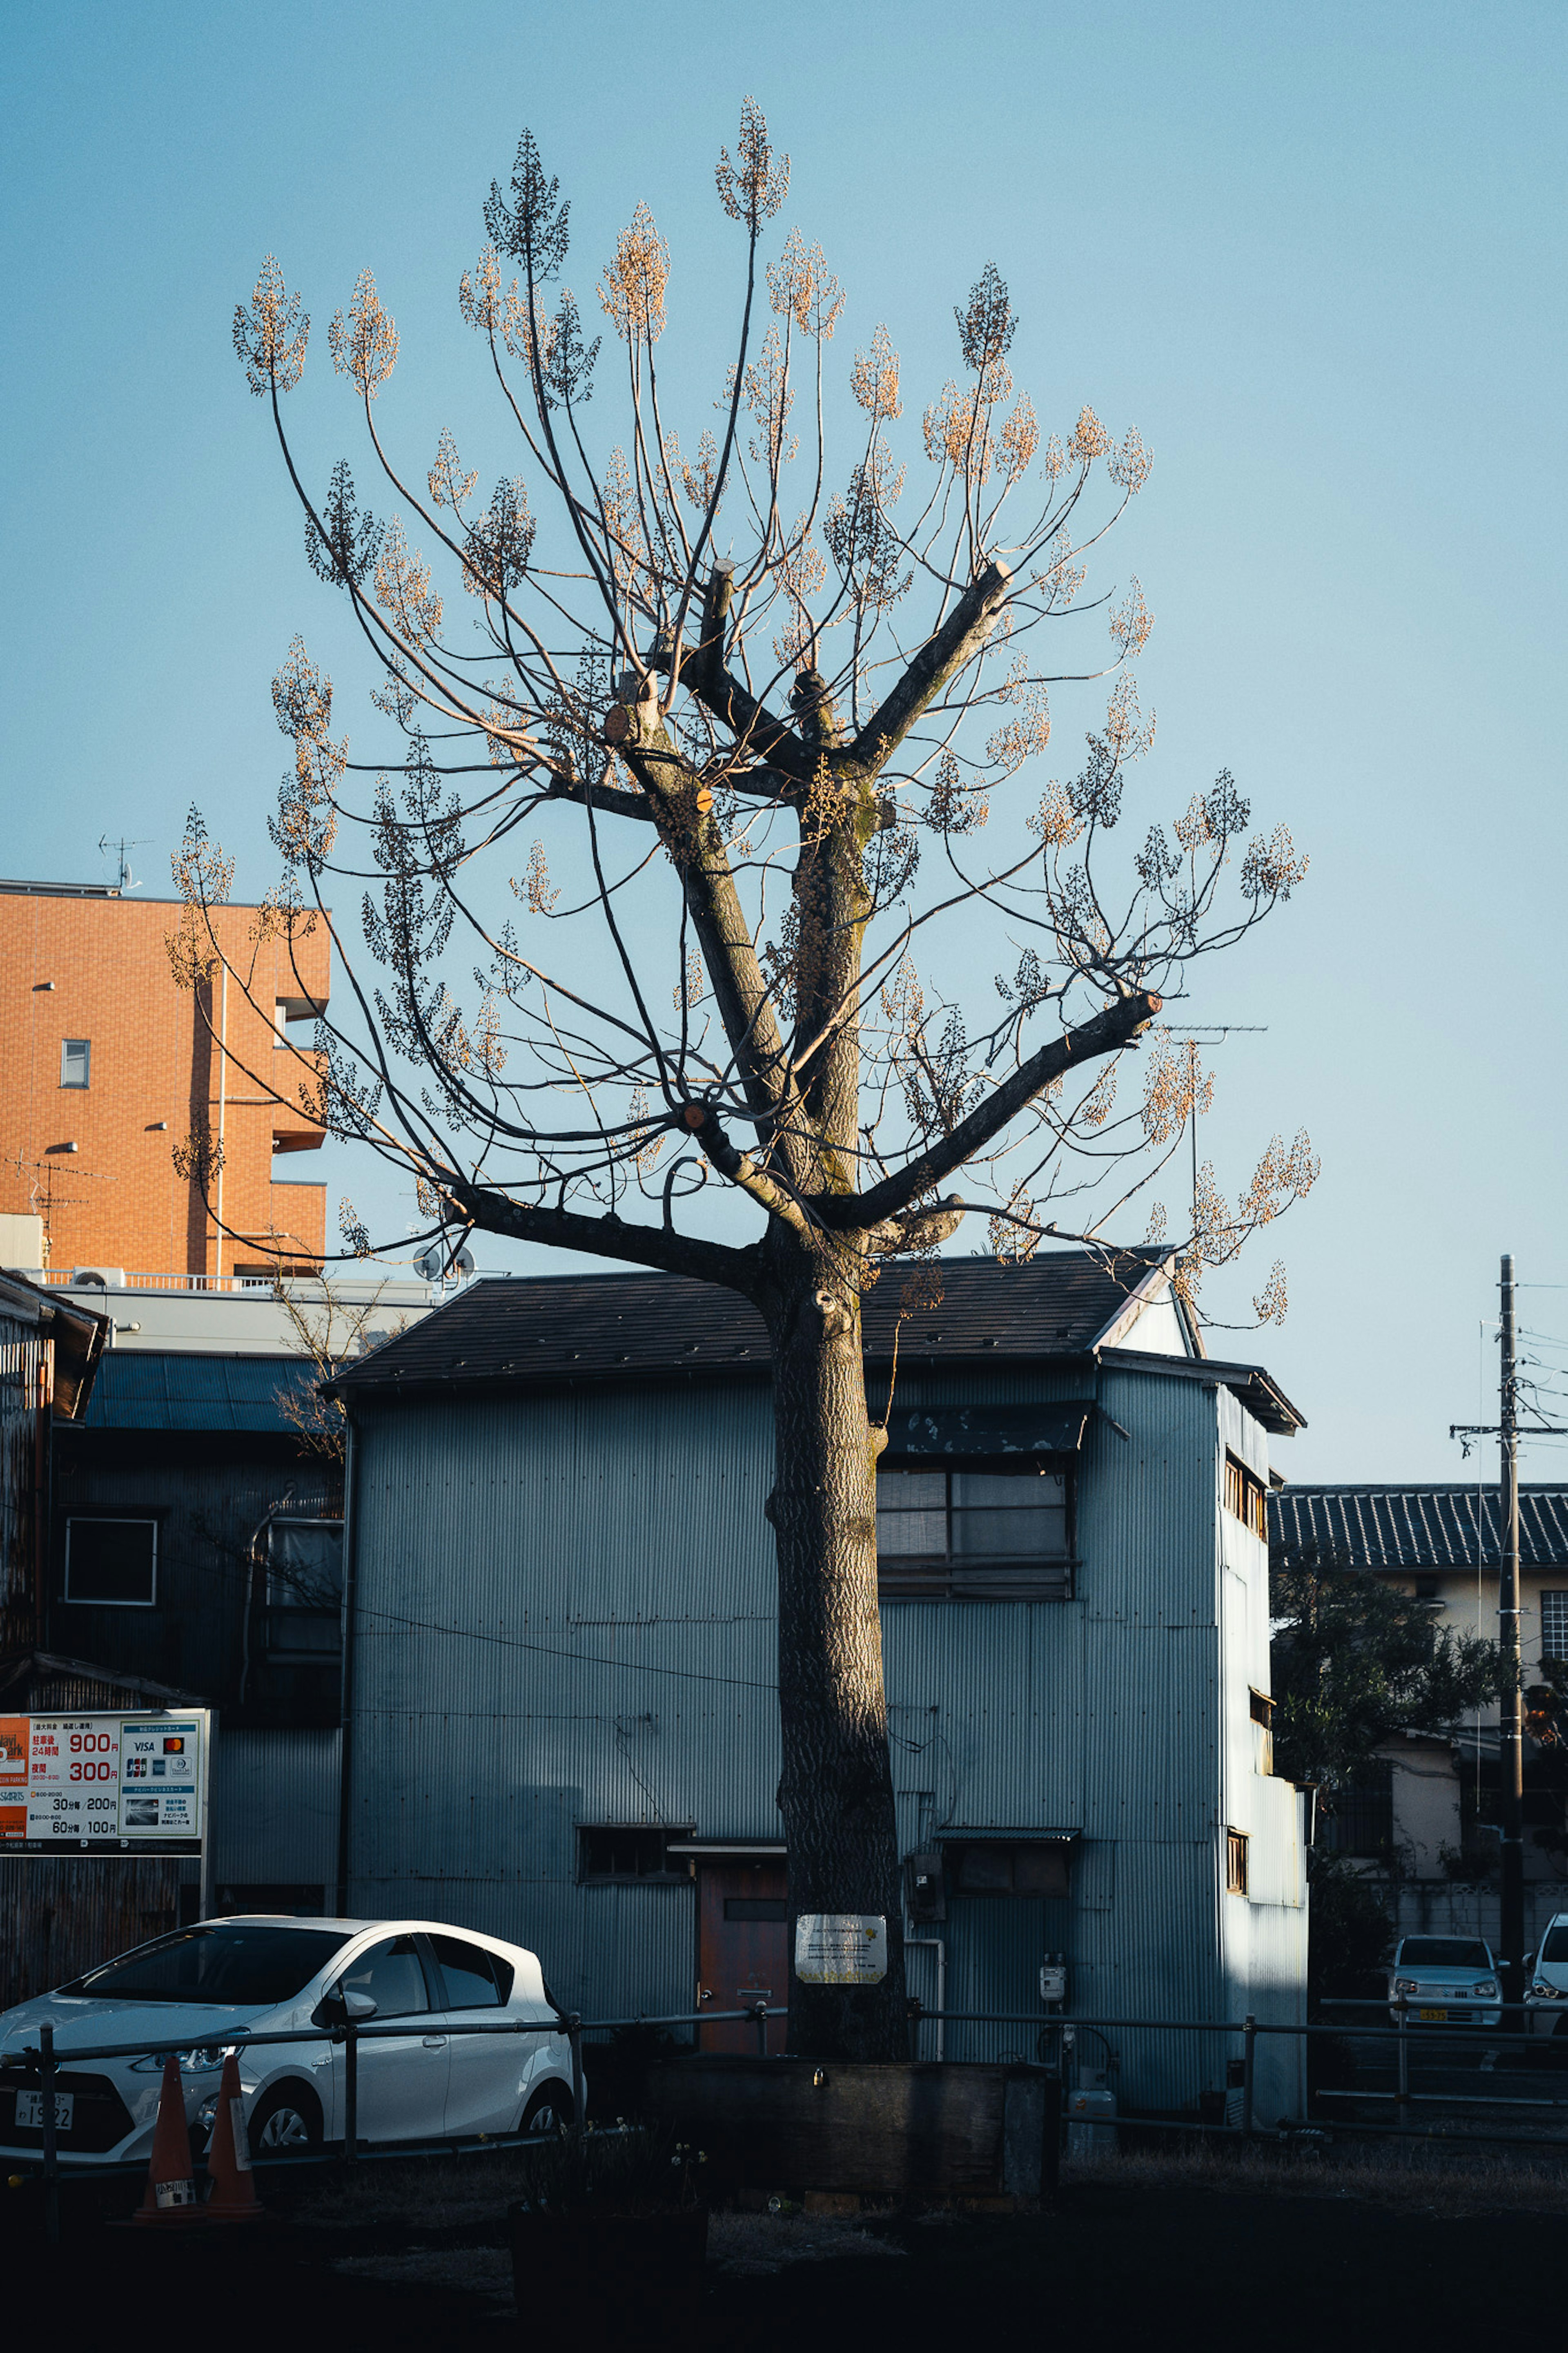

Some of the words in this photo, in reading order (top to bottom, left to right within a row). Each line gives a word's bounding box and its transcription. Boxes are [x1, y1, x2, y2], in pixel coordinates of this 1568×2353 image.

[33, 1735, 54, 1745] 駐車後
[70, 1734, 118, 1753] 900円
[32, 1746, 59, 1756] 24時間
[134, 1742, 154, 1751] VISA
[32, 1764, 46, 1773] 夜間
[70, 1762, 118, 1781] 300円
